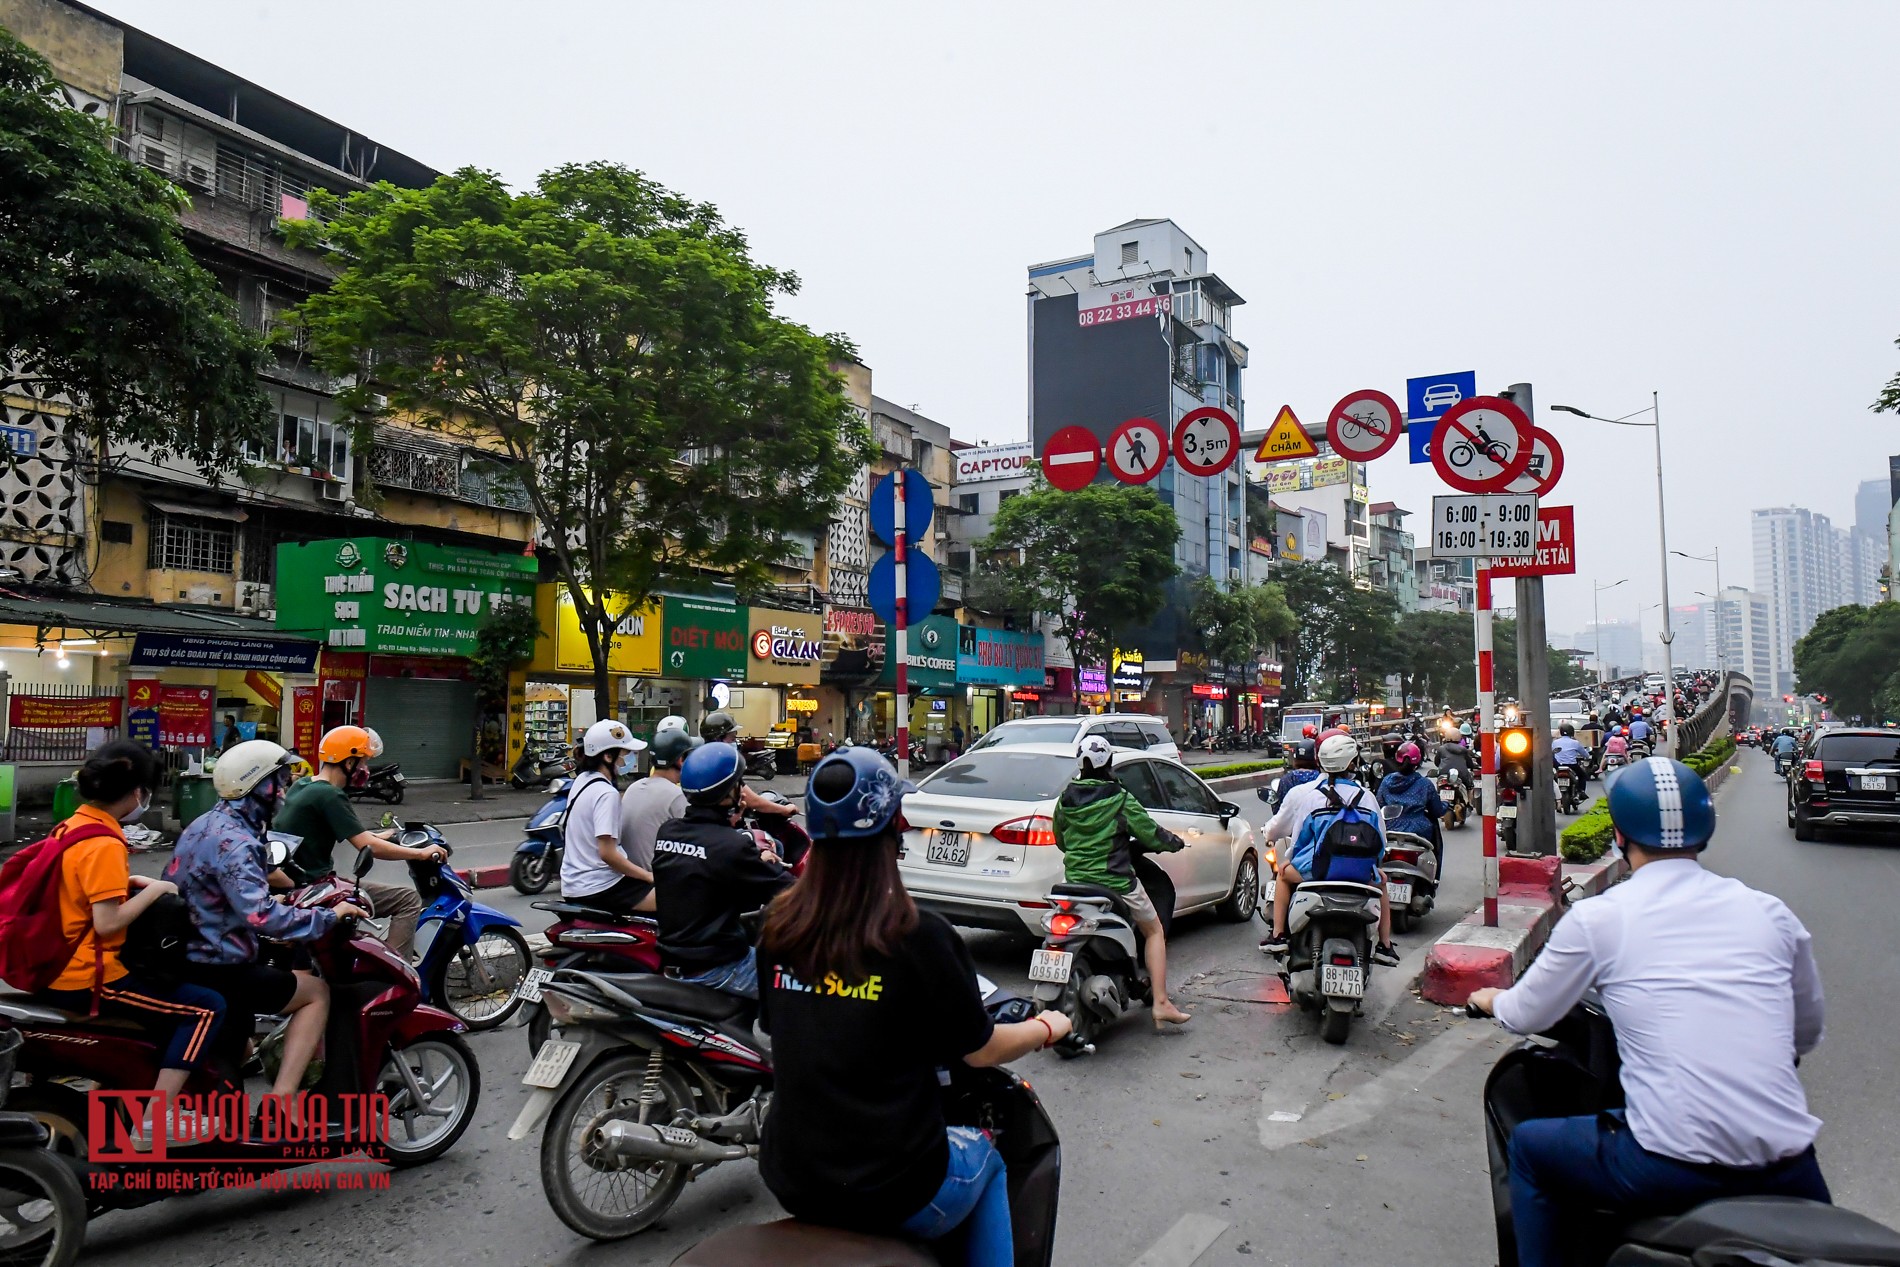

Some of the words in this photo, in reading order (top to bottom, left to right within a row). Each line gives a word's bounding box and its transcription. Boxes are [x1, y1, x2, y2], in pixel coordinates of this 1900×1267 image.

[1079, 311, 1094, 326] 08
[1097, 308, 1112, 322] 22
[1116, 305, 1131, 319] 33
[1135, 301, 1151, 315] 44
[1280, 432, 1290, 440] ĐI
[1446, 505, 1477, 523] 6:00
[1499, 504, 1530, 522] 9:00
[1438, 531, 1475, 549] 16:00
[1490, 530, 1530, 548] 19:30
[383, 582, 448, 618] SẠCH
[453, 583, 484, 615] TỪ
[827, 609, 875, 636] ESPRESSO
[170, 649, 186, 658] CÁC
[233, 653, 251, 661] SINH
[927, 657, 956, 671] COFFEE
[940, 832, 959, 847] 30A
[655, 840, 708, 860] HONDA
[931, 846, 965, 863] 124.62
[1040, 952, 1066, 967] 19-B1
[1325, 981, 1360, 996] 024.70
